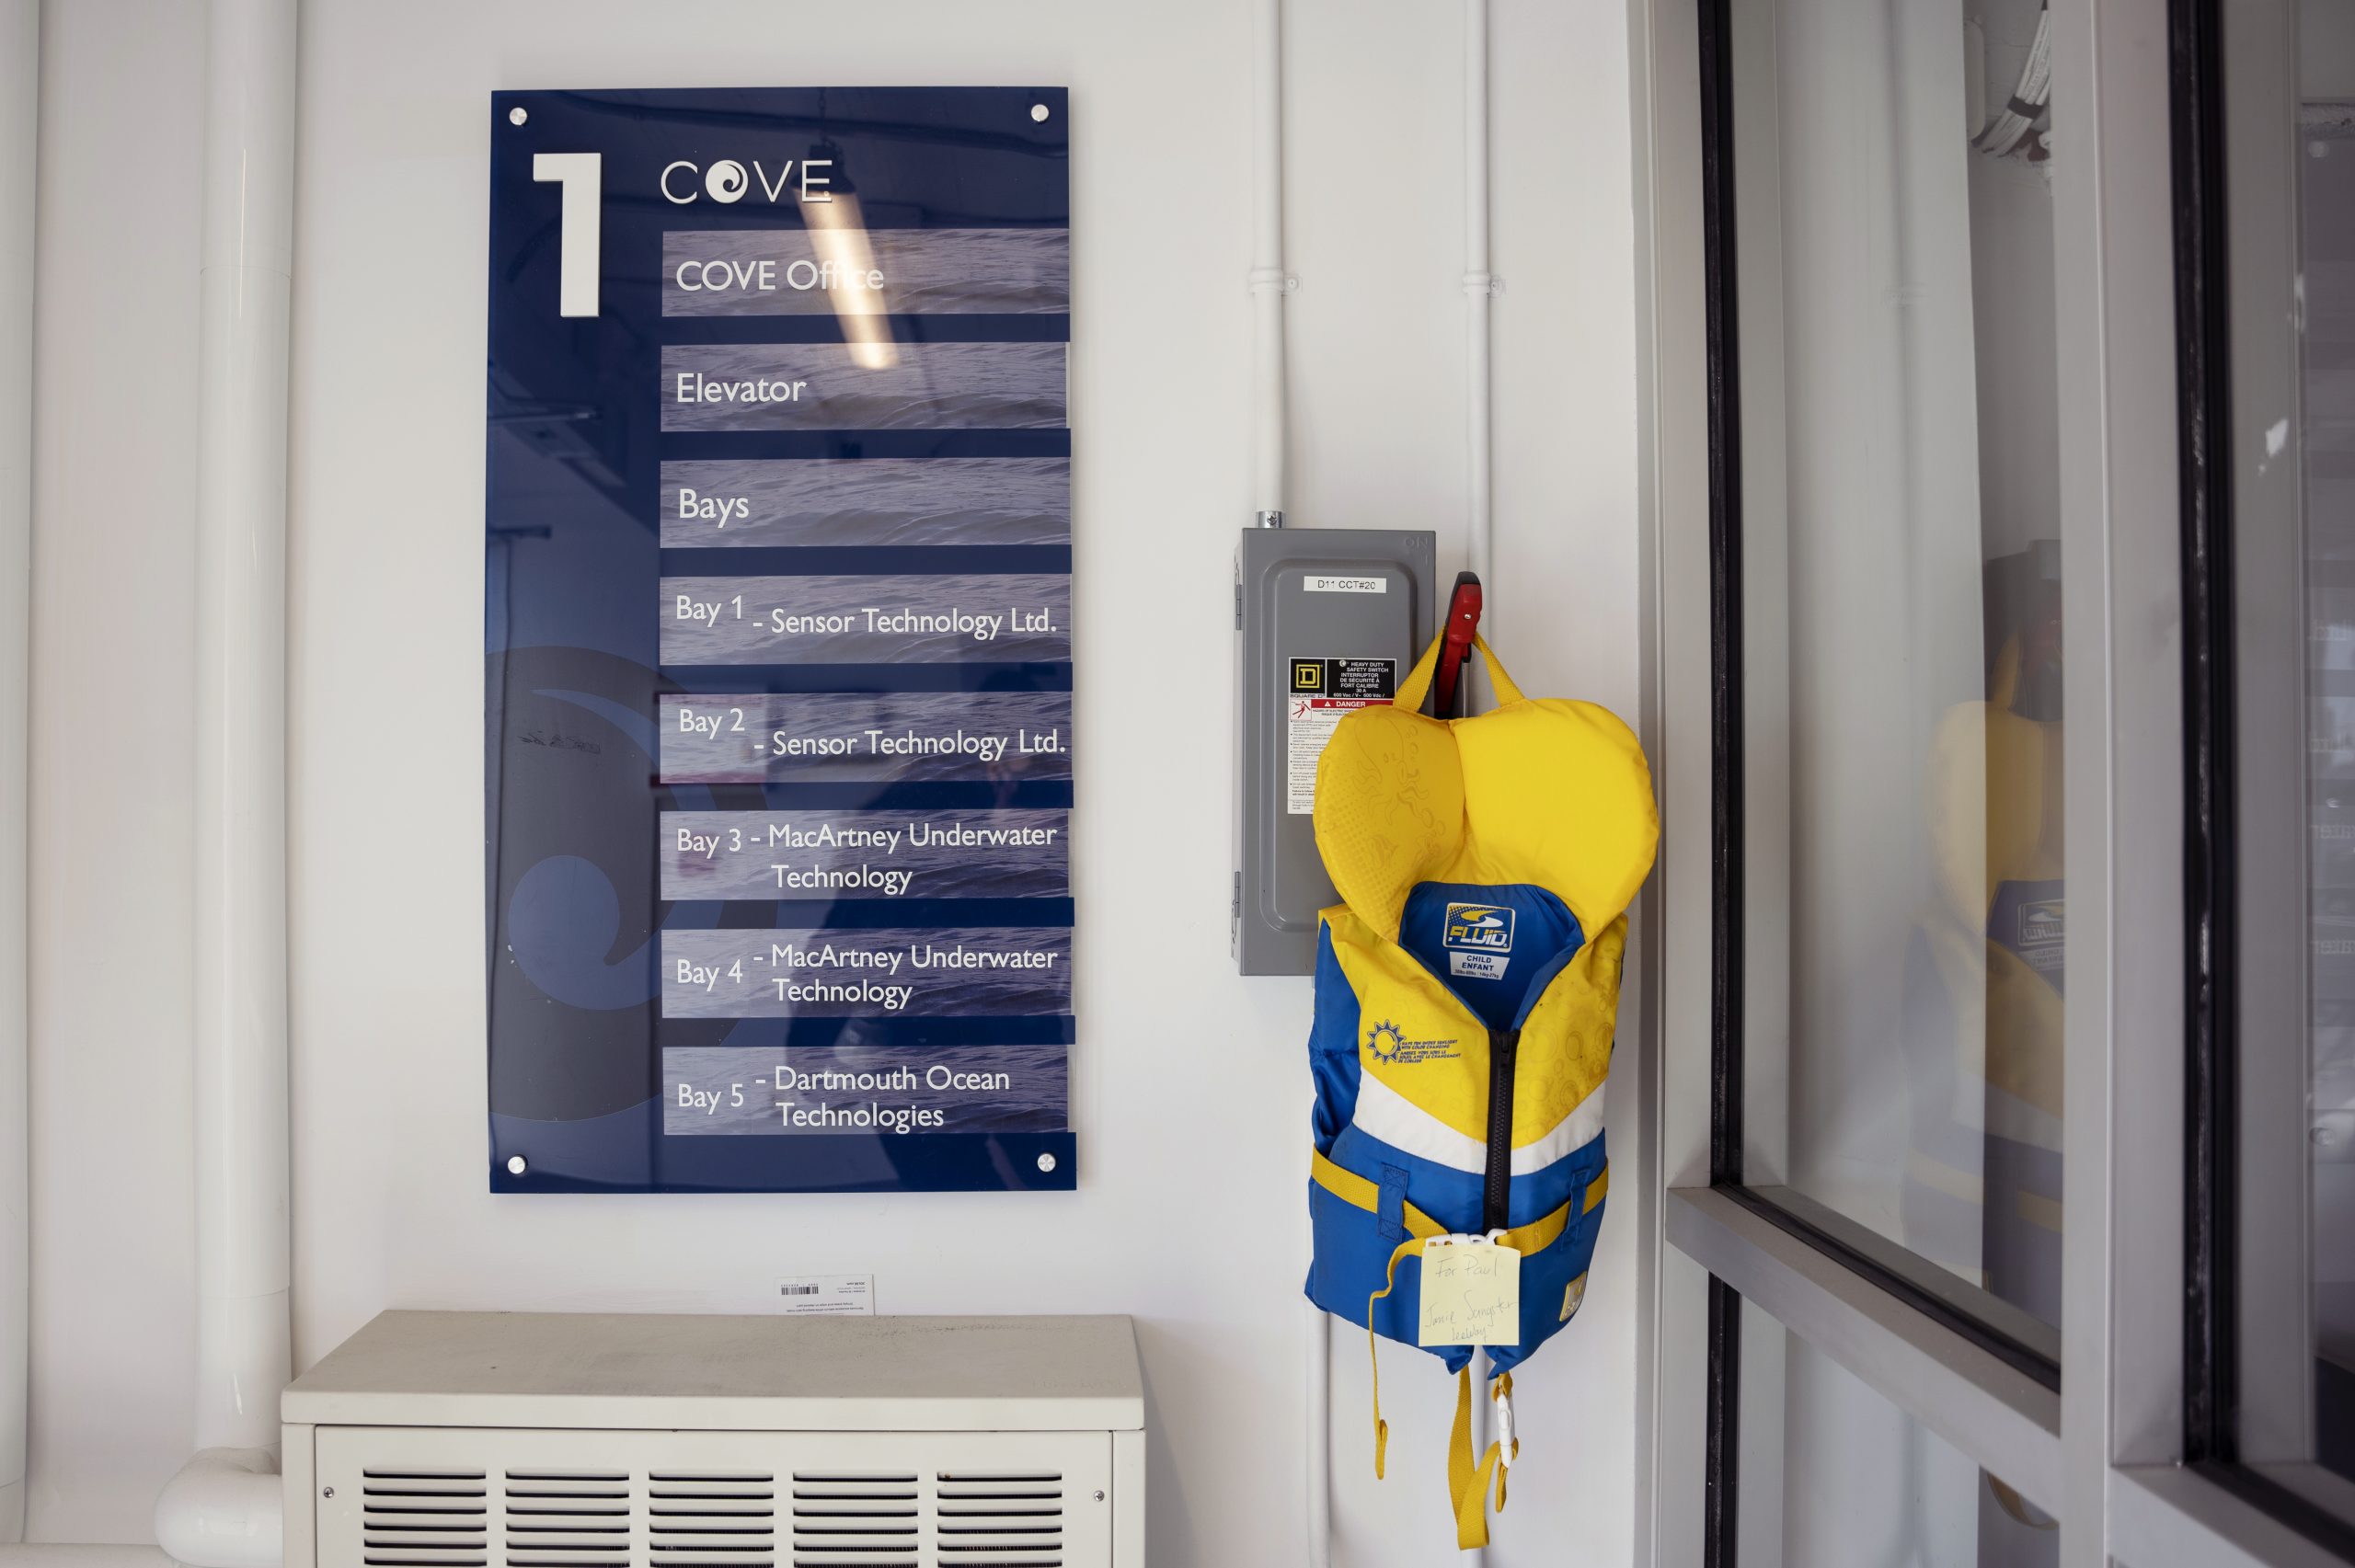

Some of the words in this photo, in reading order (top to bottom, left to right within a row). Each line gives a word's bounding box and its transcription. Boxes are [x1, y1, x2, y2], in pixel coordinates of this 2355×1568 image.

[661, 159, 833, 204] COVE
[533, 153, 602, 318] 1
[676, 260, 776, 292] COVE
[787, 259, 884, 291] Office
[676, 372, 808, 403] Elevator
[679, 488, 750, 529] Bays
[1317, 579, 1336, 589] D11
[1338, 580, 1376, 589] CCT#20
[676, 595, 722, 624] Bay
[731, 595, 741, 619] 1
[771, 608, 856, 634] Sensor
[861, 607, 1003, 641] Technology
[1011, 607, 1058, 633] Ltd.
[680, 708, 722, 739] Bay
[729, 707, 745, 731] 2
[773, 730, 858, 756] Sensor
[864, 729, 1009, 762] Technology
[1019, 728, 1066, 753] Ltd.
[678, 828, 720, 859] Bay
[729, 828, 741, 853] 3
[769, 823, 902, 853] MacArtney
[909, 822, 1058, 847] Underwater
[771, 864, 913, 899] Technology
[1448, 925, 1508, 946] FLUID
[677, 959, 720, 991] Bay
[728, 958, 743, 983] 4
[772, 944, 903, 975] MacArtney
[911, 944, 1059, 968] Underwater
[1462, 962, 1495, 971] ENFANT
[1466, 955, 1492, 963] CHILD
[772, 978, 913, 1010] Technology
[775, 1065, 917, 1091] Dartmouth
[925, 1065, 1010, 1091] Ocean
[678, 1083, 722, 1116] Bay
[730, 1083, 744, 1107] 5
[775, 1102, 945, 1135] Technologies
[1436, 1256, 1458, 1278] For
[1464, 1253, 1498, 1277] Paul
